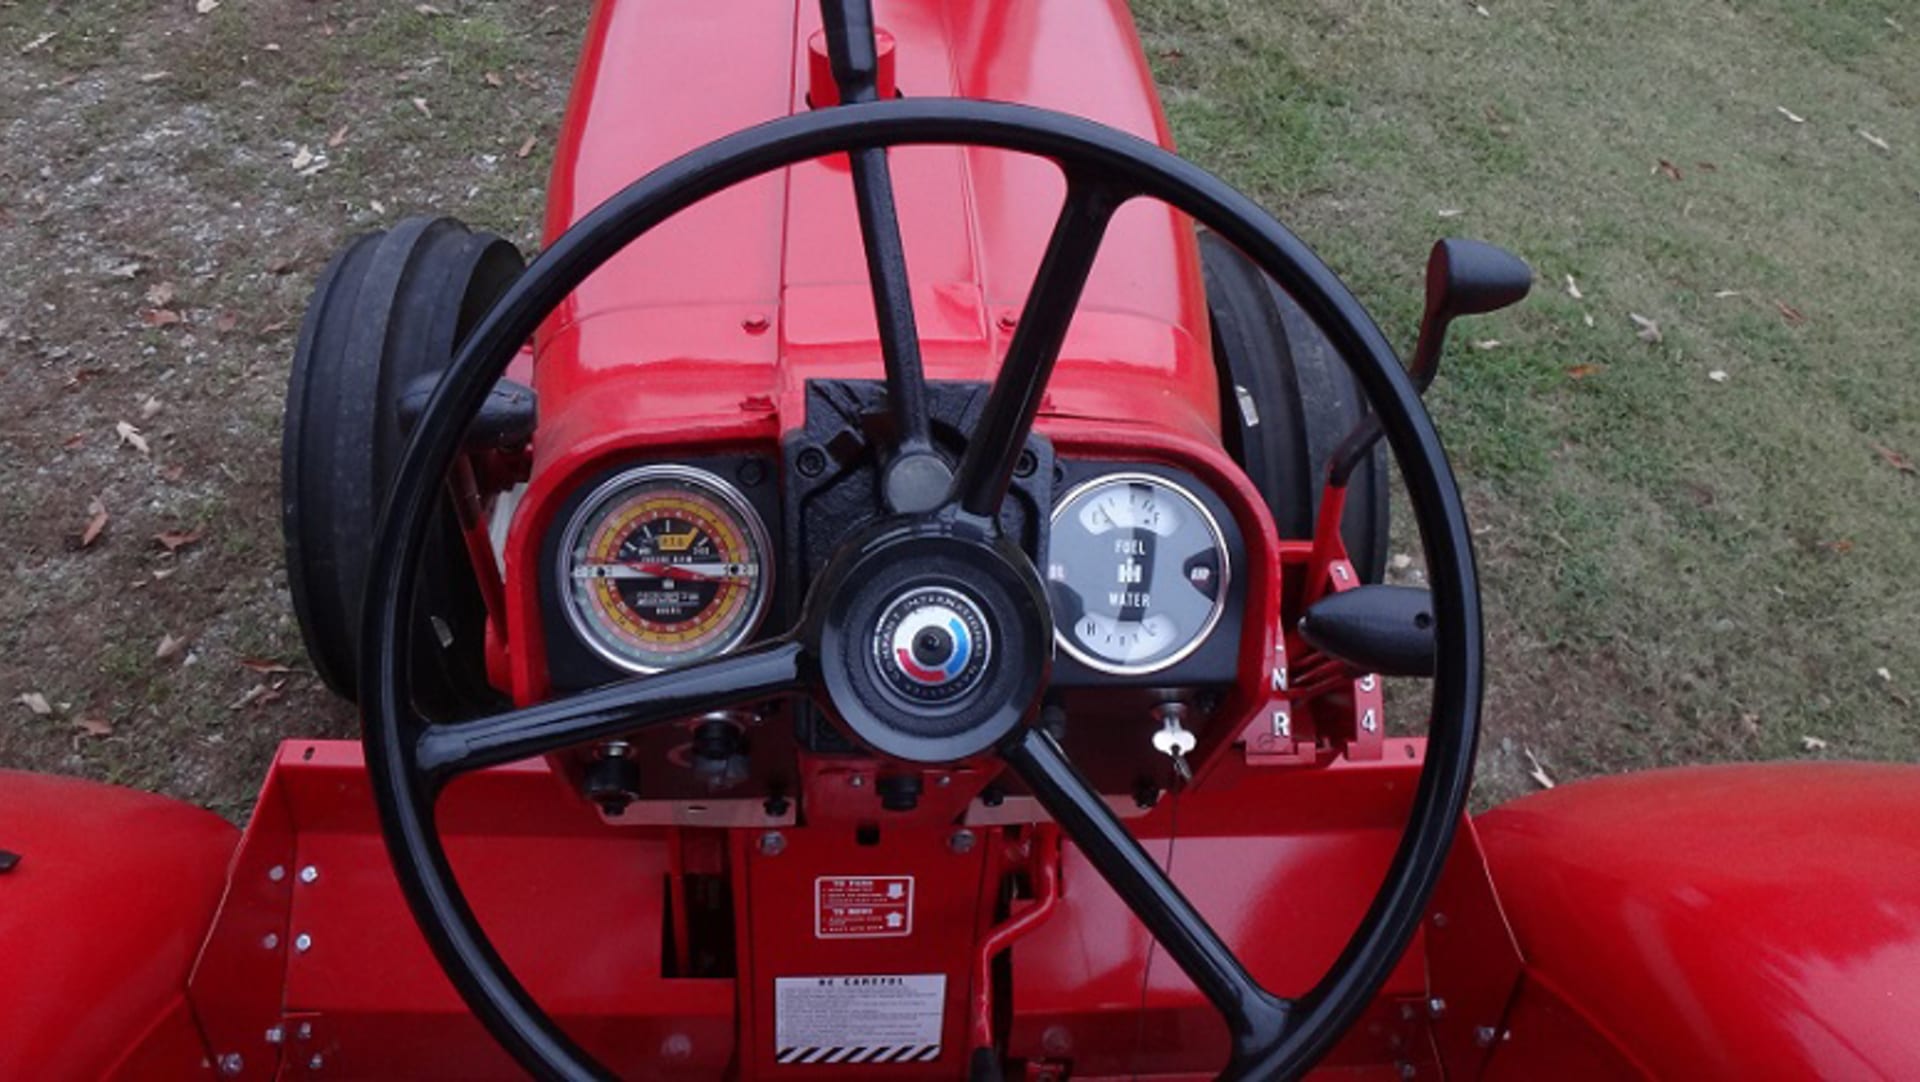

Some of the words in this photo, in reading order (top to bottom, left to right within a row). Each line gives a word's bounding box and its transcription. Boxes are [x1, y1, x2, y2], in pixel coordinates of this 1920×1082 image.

[1115, 540, 1146, 555] FUEL
[1109, 592, 1150, 607] WATER
[1087, 622, 1096, 636] H
[1273, 667, 1287, 690] N
[1274, 712, 1290, 736] R
[1362, 709, 1376, 732] 4
[844, 977, 904, 986] CAREFUL
